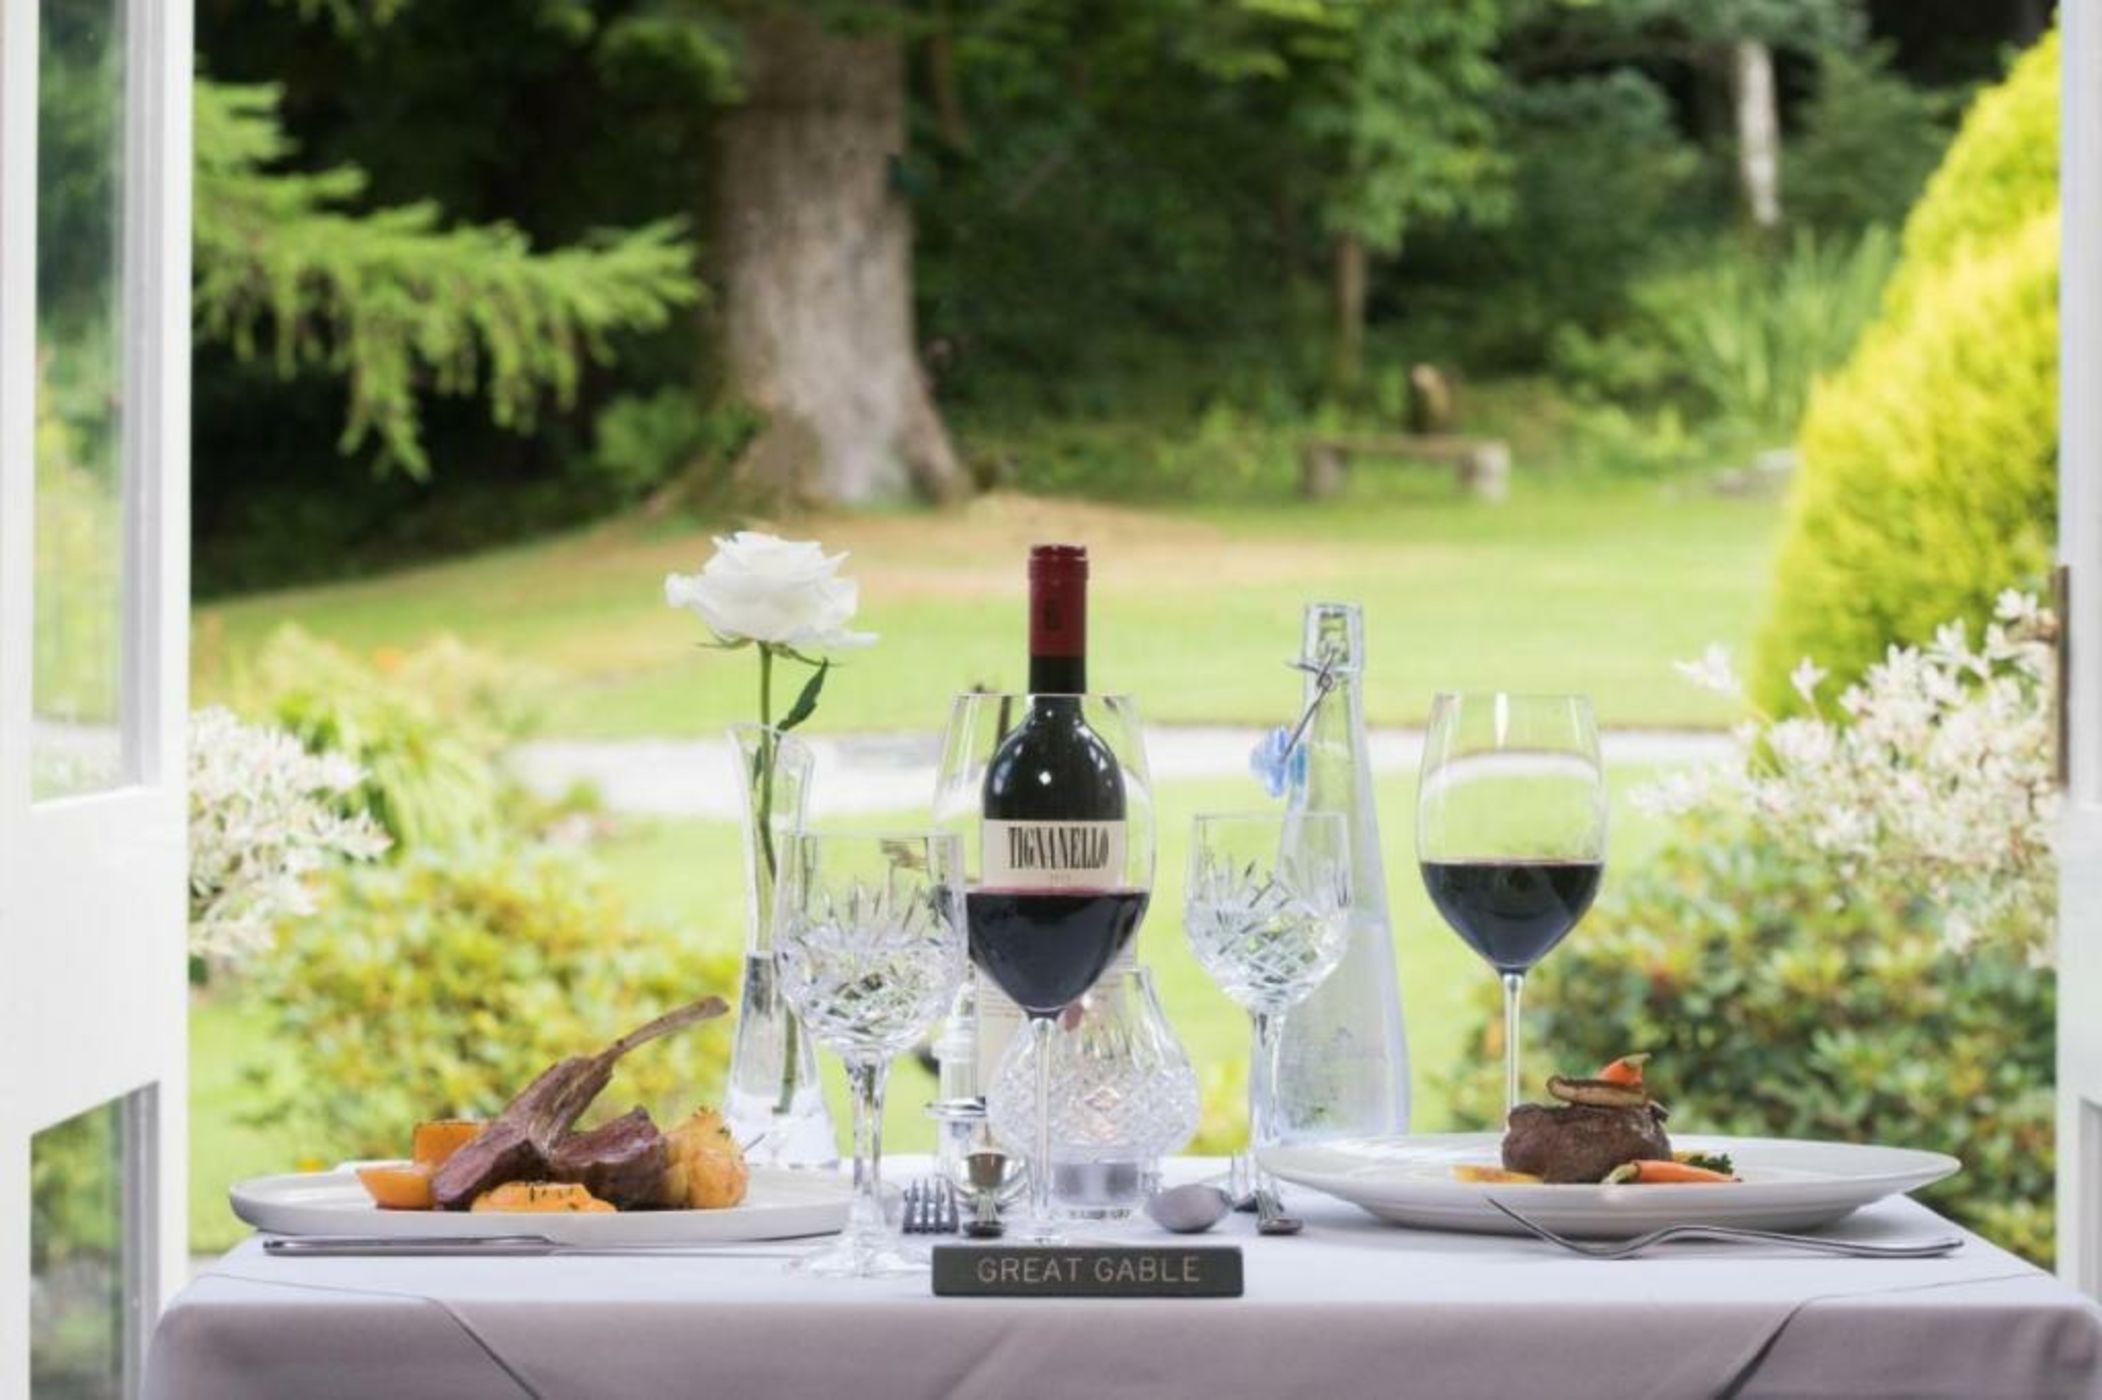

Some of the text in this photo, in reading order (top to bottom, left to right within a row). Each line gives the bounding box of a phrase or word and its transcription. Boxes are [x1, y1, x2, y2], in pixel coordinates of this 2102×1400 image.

[1008, 827, 1109, 869] TIGNANELLO
[977, 1256, 1201, 1282] GREAT GABLE
